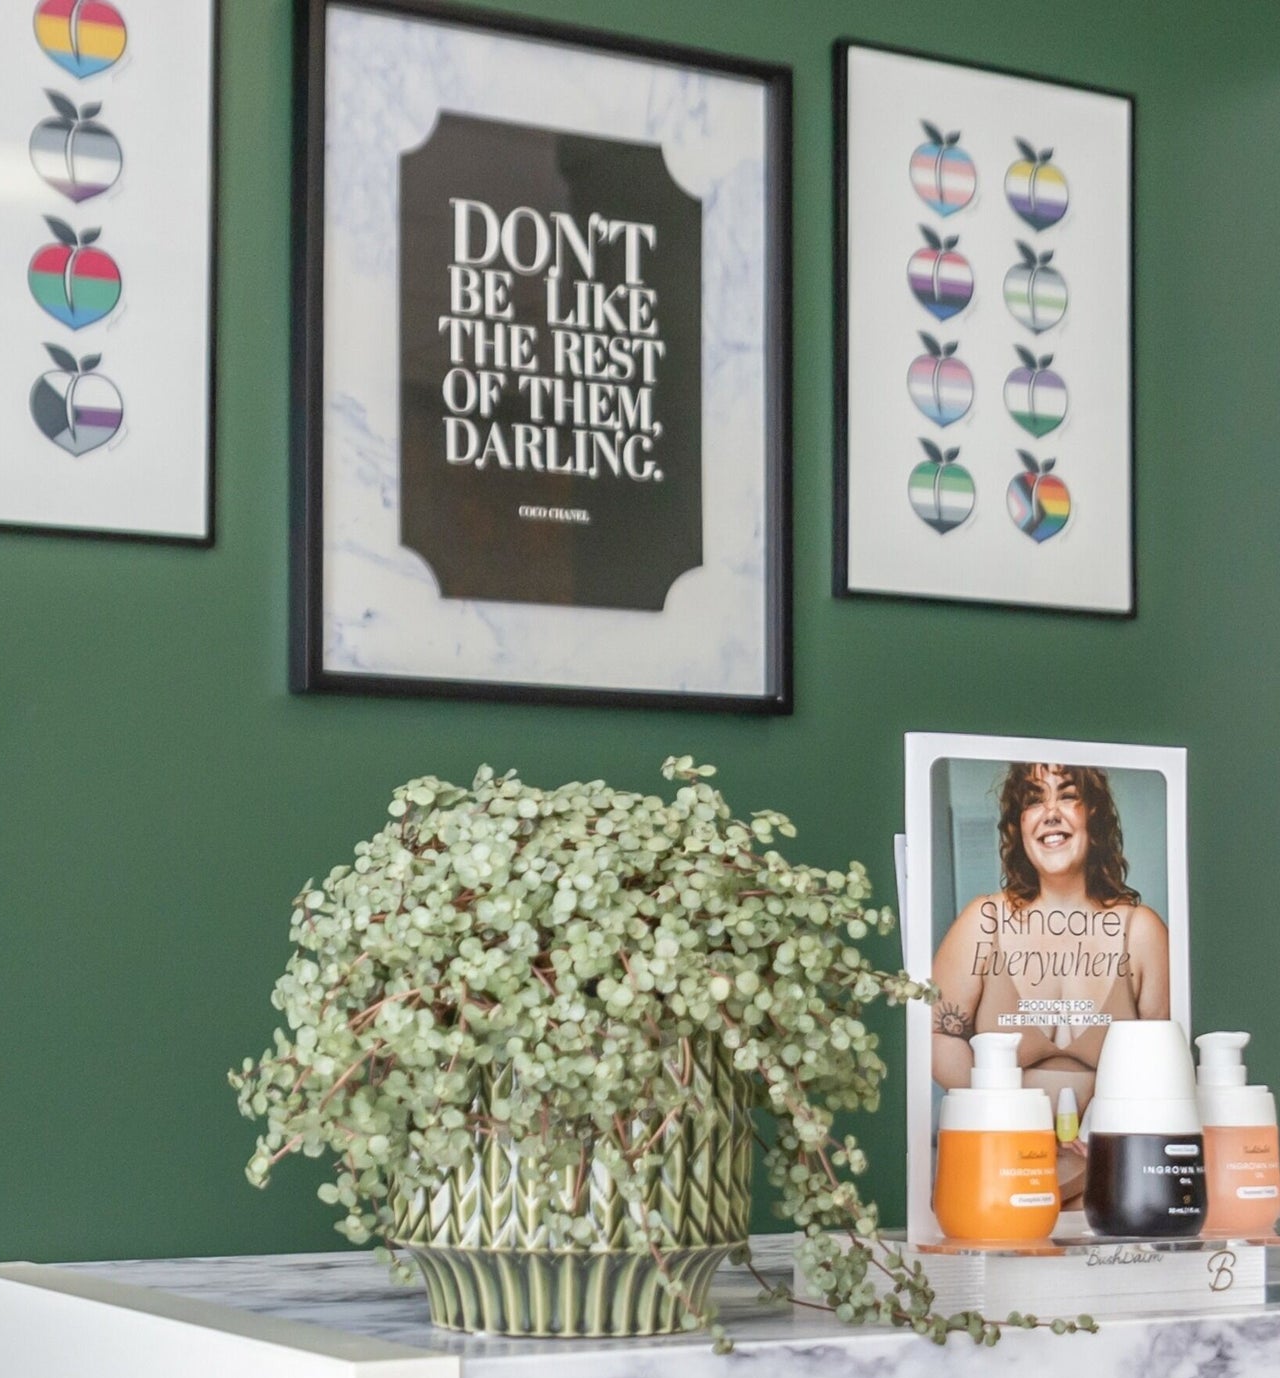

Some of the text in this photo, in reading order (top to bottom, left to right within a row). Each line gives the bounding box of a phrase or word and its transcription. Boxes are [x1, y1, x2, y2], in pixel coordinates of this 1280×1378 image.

[449, 198, 657, 285] DON'T
[448, 265, 658, 336] BE LIKE
[439, 316, 666, 384] THE REST
[442, 368, 663, 436] OF THEM,
[442, 417, 664, 482] DARLING.
[519, 506, 590, 522] COCO CHANEL
[971, 941, 1134, 987] Everywhere.
[999, 1015, 1017, 1025] THE
[1021, 1015, 1049, 1025] BIKINI
[1052, 1015, 1071, 1025] LINE
[1082, 1015, 1111, 1025] MORE
[1018, 1001, 1093, 1011] PRODUCTS FOR
[1143, 1165, 1195, 1175] INGROWN
